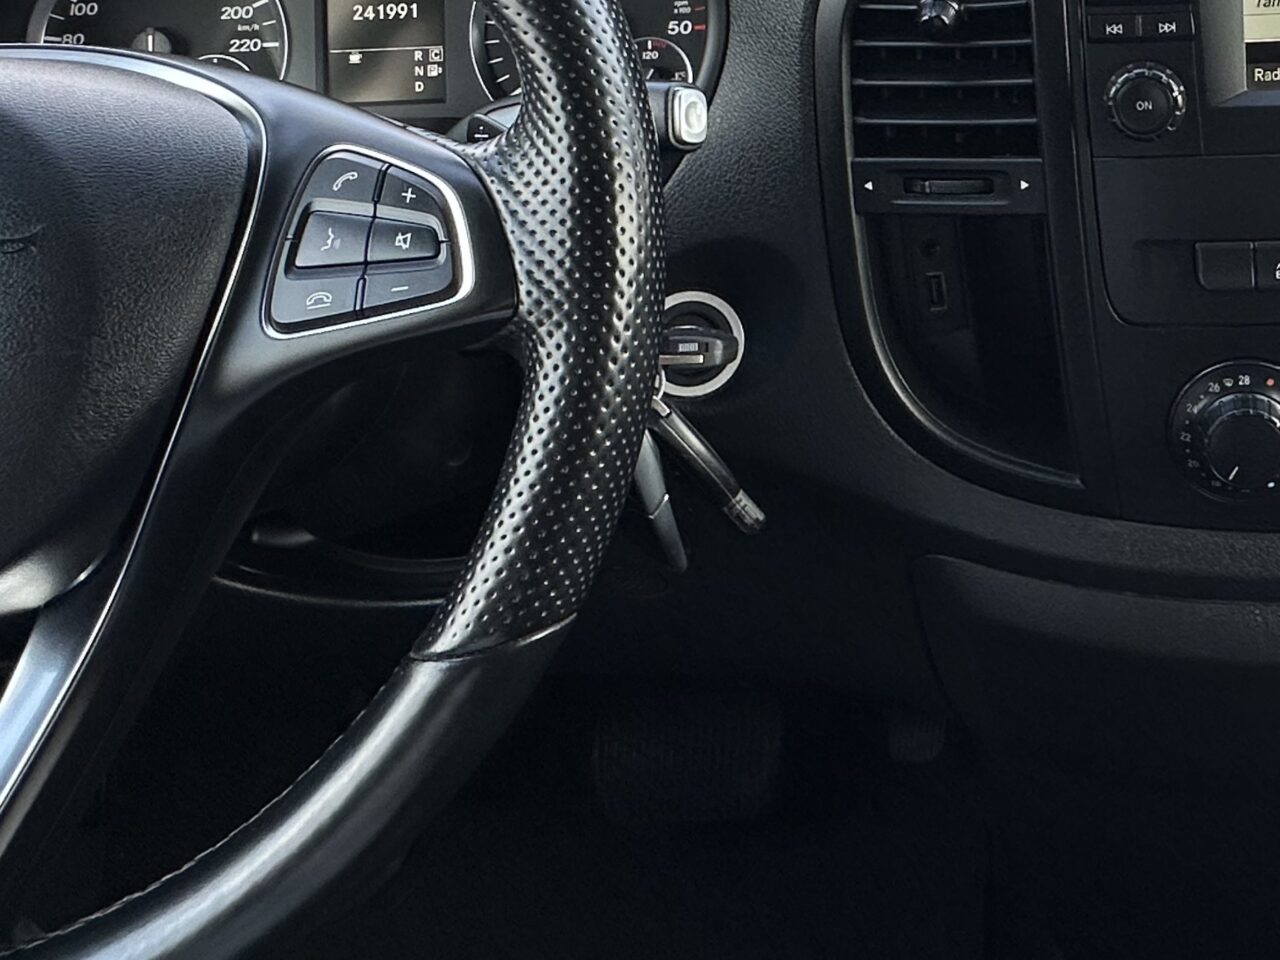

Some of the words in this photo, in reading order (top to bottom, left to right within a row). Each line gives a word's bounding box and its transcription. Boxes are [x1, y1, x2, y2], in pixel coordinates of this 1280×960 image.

[69, 2, 98, 16] 100
[673, 0, 689, 8] rpm
[220, 6, 254, 20] 200
[352, 3, 418, 21] 241991
[237, 23, 260, 32] km/h
[667, 20, 693, 35] 50
[62, 33, 85, 45] 80
[229, 39, 262, 53] 220
[414, 50, 424, 62] R
[431, 51, 441, 61] C
[642, 50, 659, 60] 120
[414, 66, 424, 77] N
[414, 81, 425, 93] D
[1136, 100, 1153, 111] ON
[1238, 375, 1251, 386] 28
[1208, 382, 1221, 393] 26
